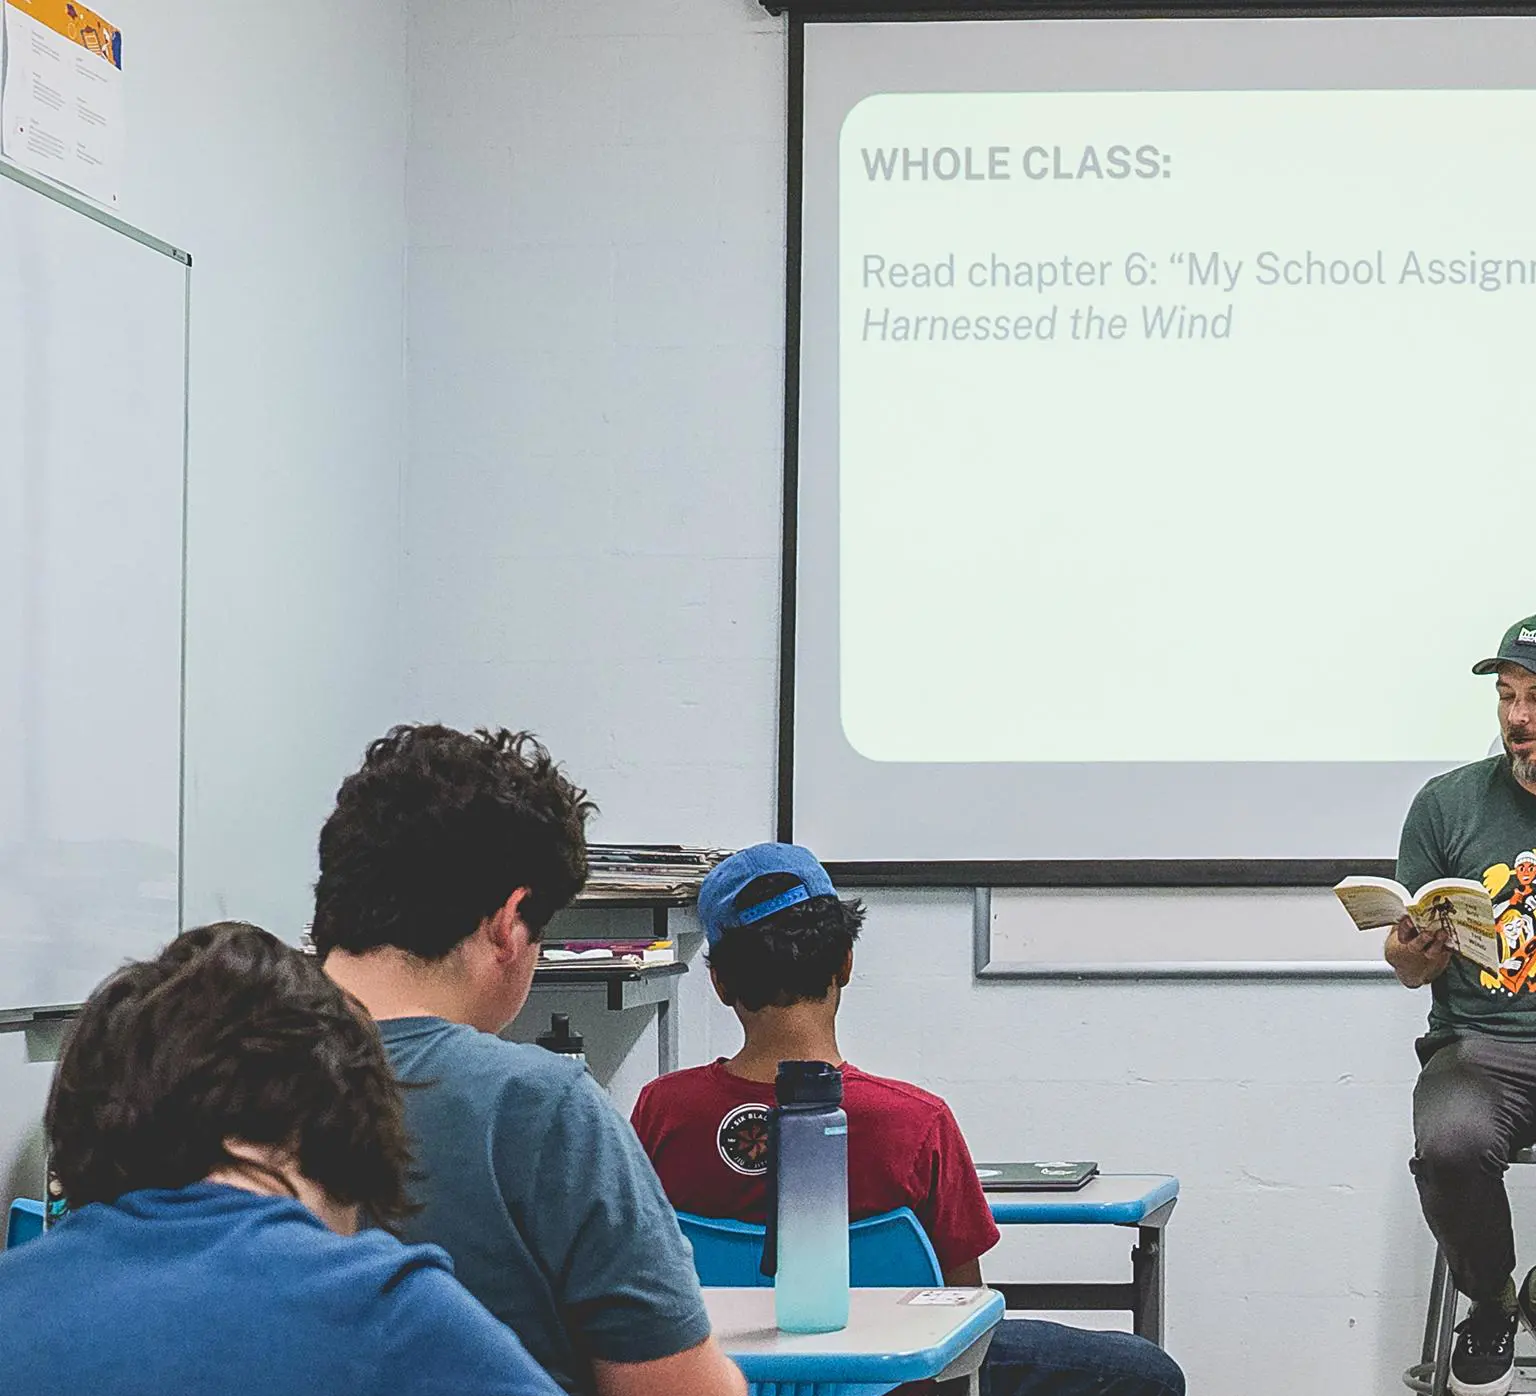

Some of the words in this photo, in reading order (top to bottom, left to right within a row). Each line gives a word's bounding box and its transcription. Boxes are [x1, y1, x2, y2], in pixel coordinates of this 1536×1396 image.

[861, 146, 1011, 181] WHOLE
[1022, 144, 1172, 180] CLASS:
[862, 253, 955, 288] Read
[967, 252, 1113, 294] chapter
[1124, 252, 1157, 287] 6:
[1169, 251, 1244, 292] “My
[1255, 250, 1387, 286] School
[861, 305, 1059, 342] Harnessed
[1069, 304, 1128, 341] the
[1141, 304, 1233, 340] Wind
[733, 1115, 746, 1127] SIX
